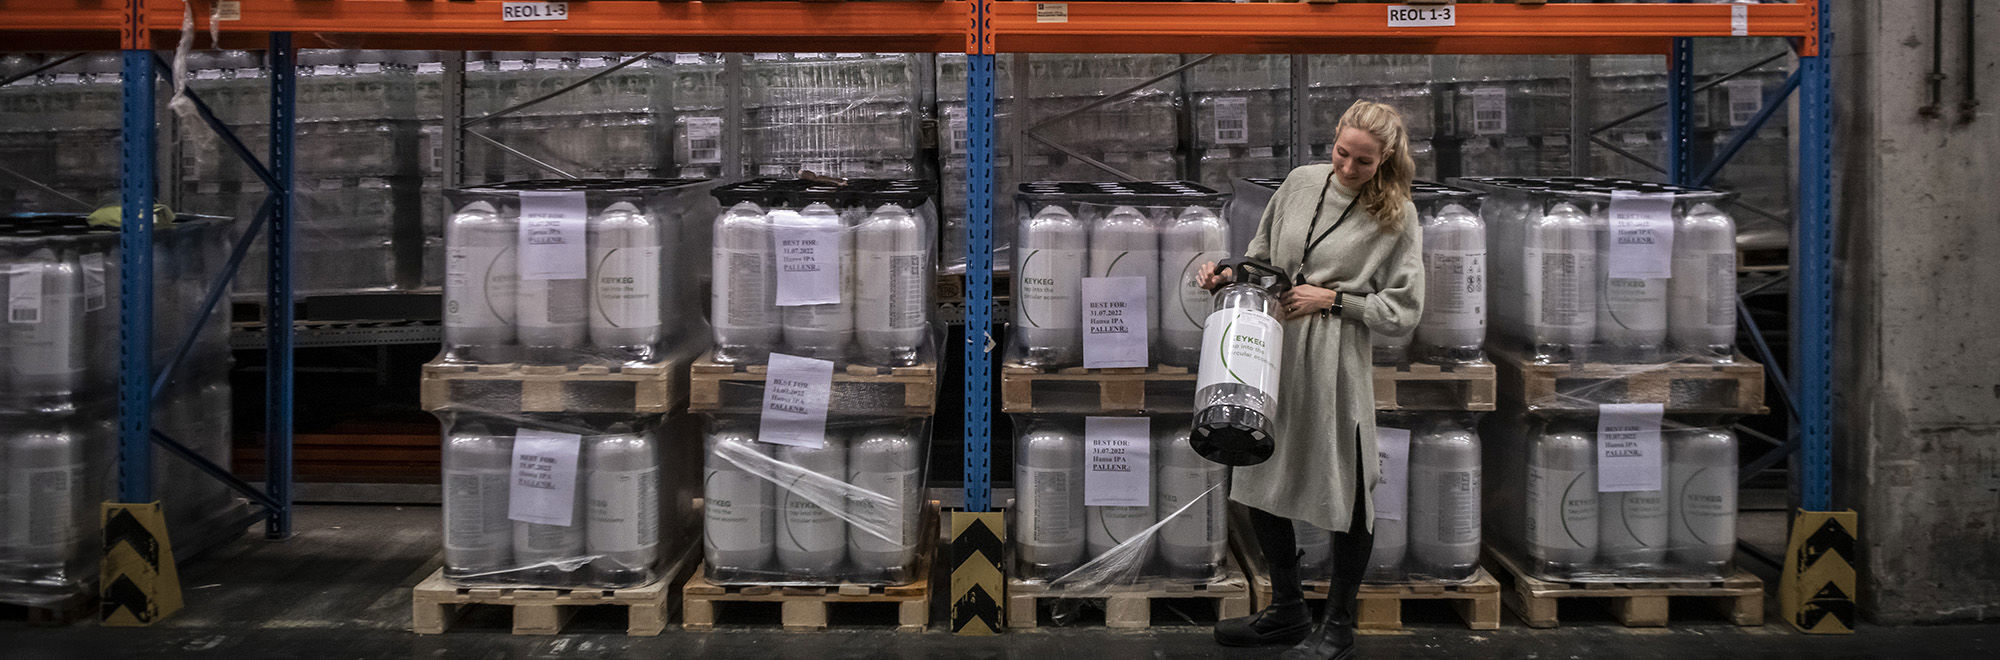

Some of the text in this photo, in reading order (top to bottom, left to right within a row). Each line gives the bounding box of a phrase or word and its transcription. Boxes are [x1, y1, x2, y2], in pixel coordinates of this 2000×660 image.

[504, 3, 566, 18] REOL 1-3
[1390, 8, 1451, 21] REOL 1-3
[1024, 278, 1055, 286] KEYKEG
[1090, 309, 1122, 317] 31.07.2022
[1233, 334, 1265, 348] EYKEG
[1240, 343, 1254, 351] into
